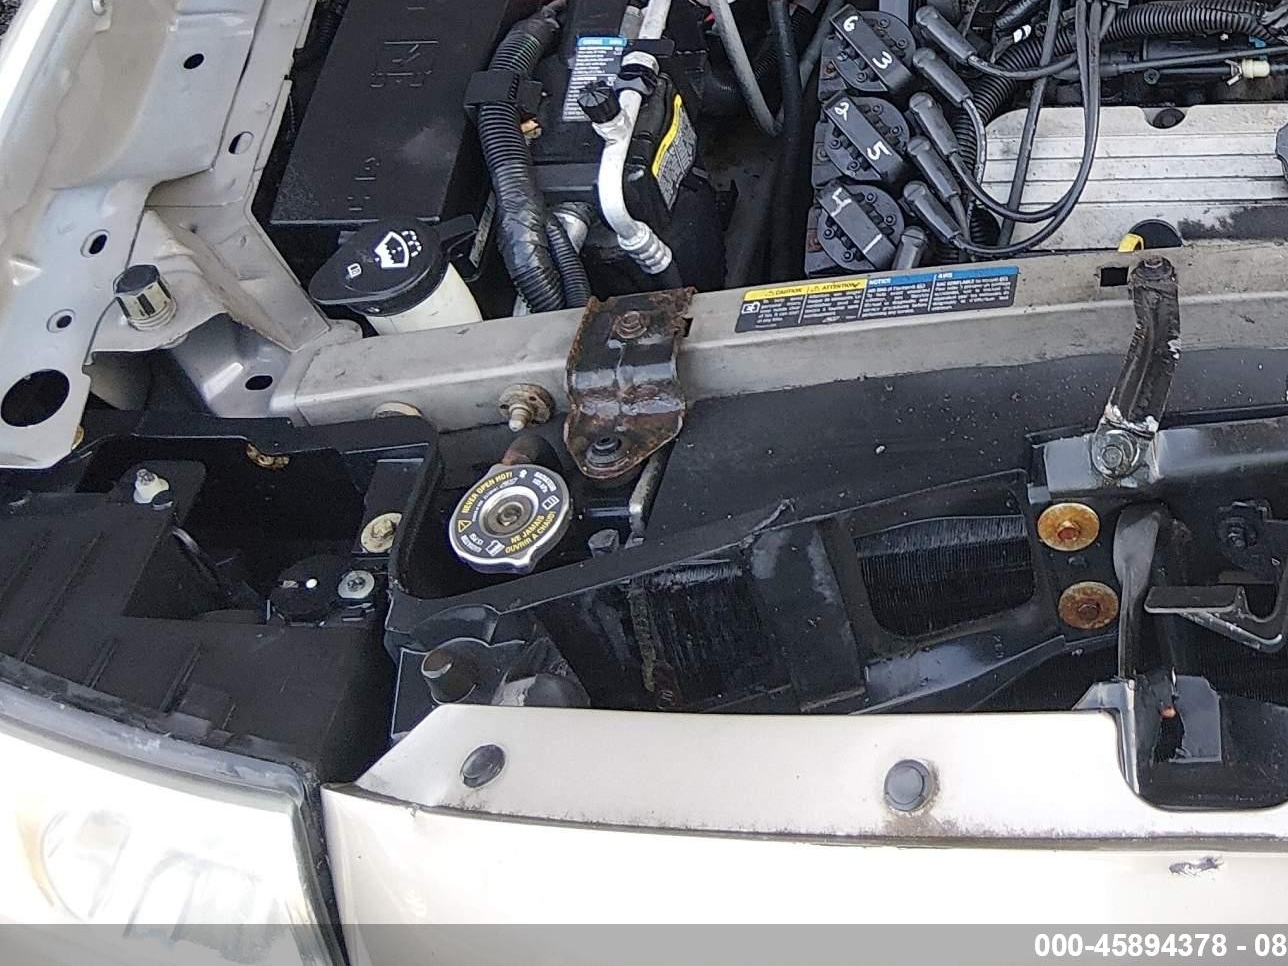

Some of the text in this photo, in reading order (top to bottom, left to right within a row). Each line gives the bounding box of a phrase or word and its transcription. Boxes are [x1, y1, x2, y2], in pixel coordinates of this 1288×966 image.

[841, 15, 859, 33] 6
[872, 50, 893, 70] 3
[833, 100, 851, 122] 2
[866, 141, 891, 162] 5
[775, 287, 802, 296] CAUTION
[822, 282, 855, 291] ATTENTION
[462, 491, 479, 514] NEVER
[478, 479, 495, 495] OPEN
[511, 515, 545, 544] NE JAMAIS
[505, 536, 532, 554] OUVRIR
